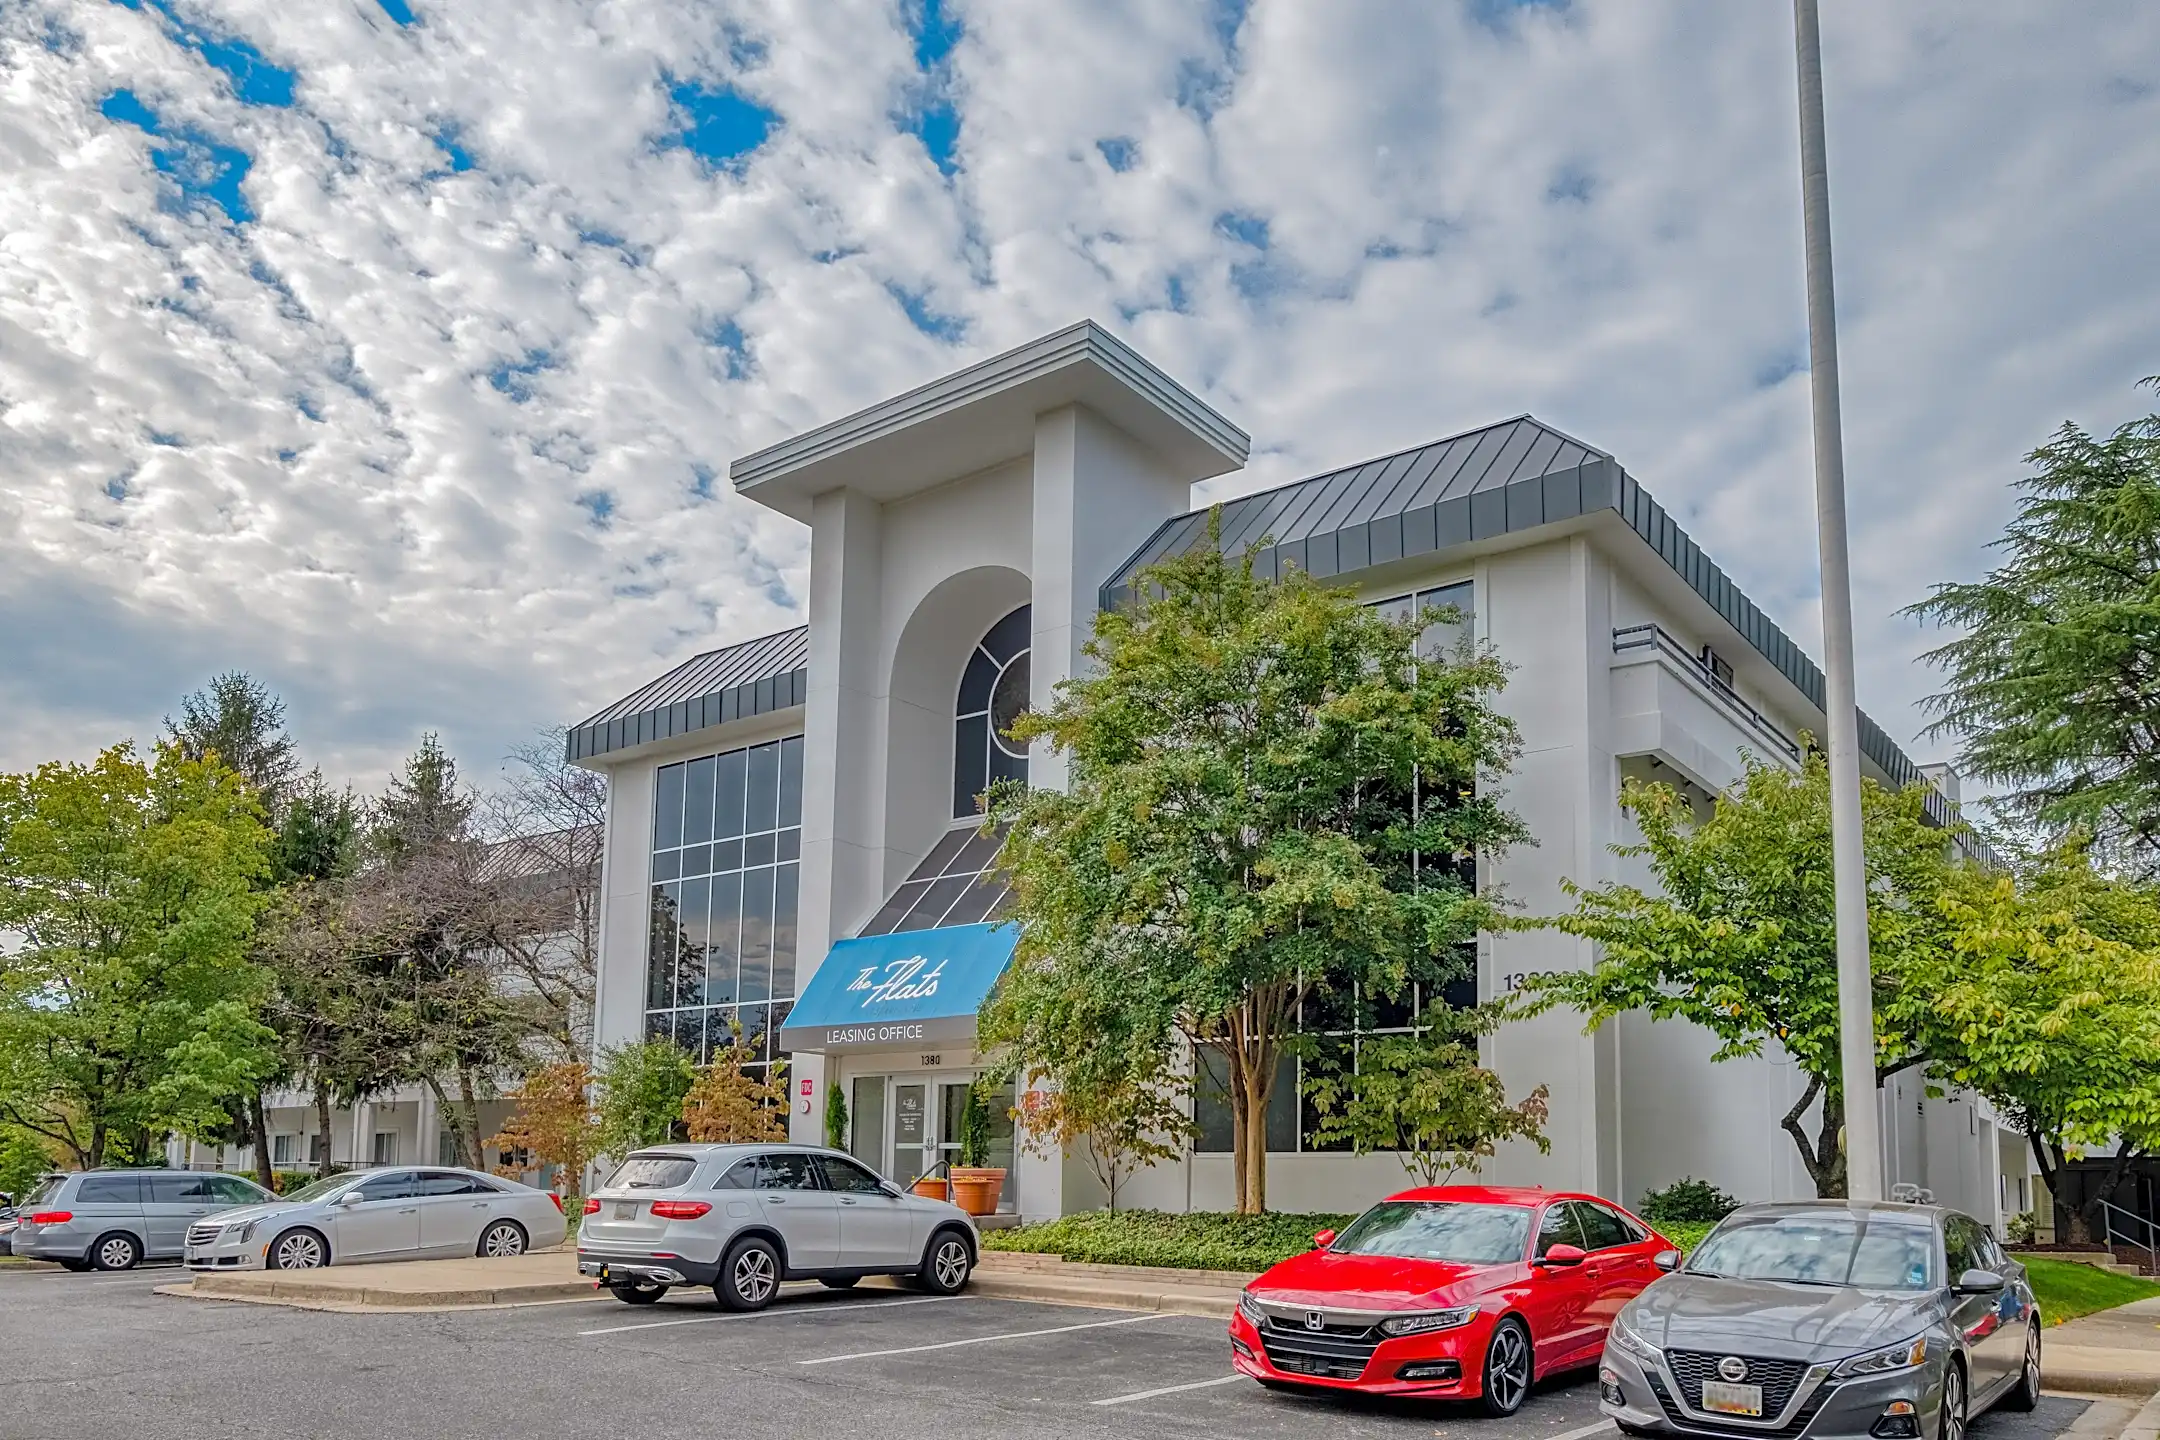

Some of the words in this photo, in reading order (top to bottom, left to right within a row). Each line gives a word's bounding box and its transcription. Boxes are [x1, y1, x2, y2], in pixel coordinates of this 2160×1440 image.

[846, 966, 878, 991] The
[862, 954, 948, 1007] Flats
[827, 1027, 875, 1043] LEASING
[879, 1025, 923, 1040] OFFICE
[921, 1055, 940, 1065] 1380
